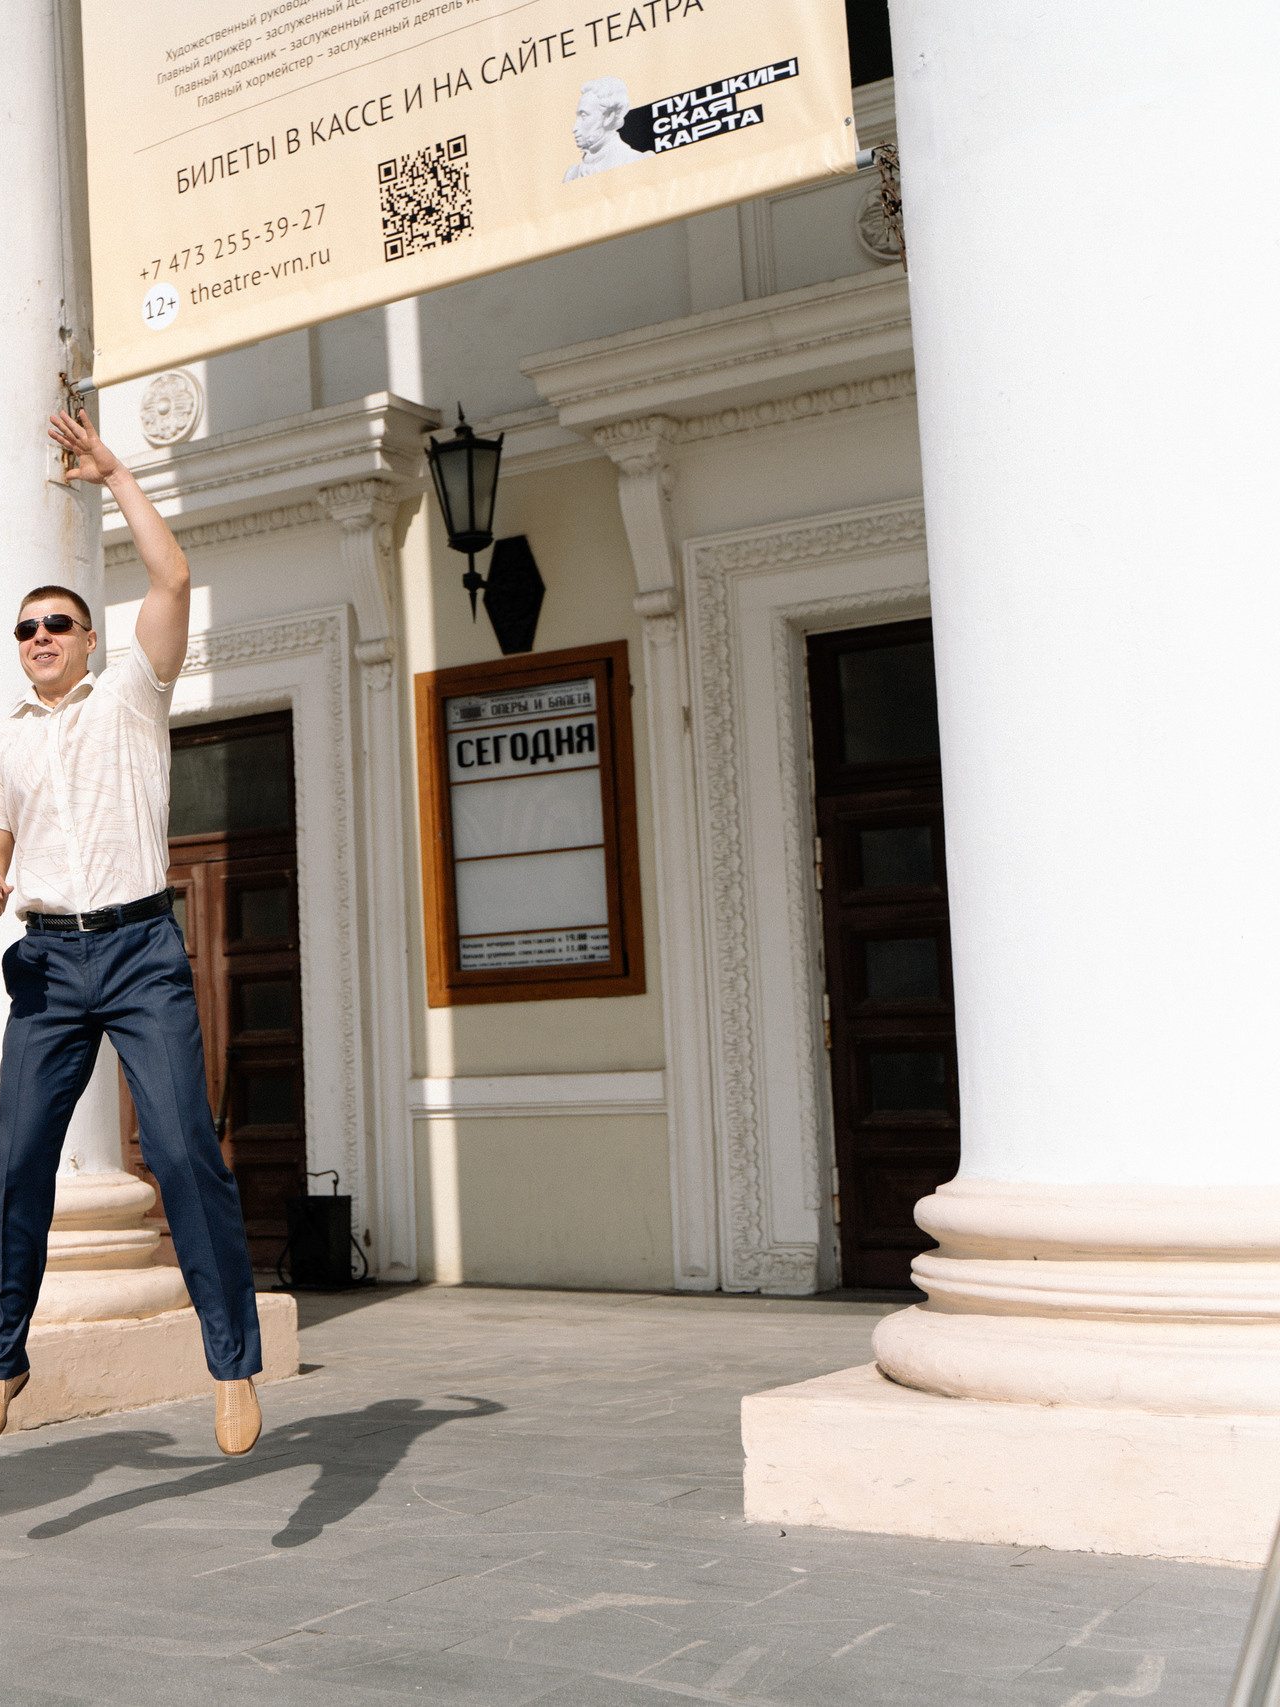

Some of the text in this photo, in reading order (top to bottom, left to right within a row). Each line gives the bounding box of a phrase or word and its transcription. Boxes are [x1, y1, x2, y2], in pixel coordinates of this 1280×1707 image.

[157, 59, 200, 85] Главный
[203, 38, 252, 67] дирижёр
[266, 2, 343, 41] заслуженный
[346, 0, 368, 9] де
[165, 0, 314, 62] Художественный руковод
[174, 70, 218, 97] Главный
[222, 49, 277, 79] художник
[290, 11, 370, 52] заслуженный
[197, 80, 242, 107] Главный
[246, 54, 313, 88] хормейстер
[327, 17, 409, 58] заслуженный
[414, 0, 463, 27] деятель
[177, 0, 704, 194] БИЛЕТЫ В КАССЕ И НА САЙТЕ ТЕАТРА
[651, 59, 797, 119] ПУШКИН
[652, 96, 734, 134] СКАЯ
[654, 106, 762, 153] КАРТА
[140, 203, 326, 280] +7 473 255-39-27
[189, 248, 331, 305] theatre-vrn.ru
[145, 296, 177, 320] 12+
[491, 700, 528, 716] ОПЕРЫ
[534, 697, 543, 711] И
[548, 692, 591, 709] БАЛЕТА
[456, 723, 596, 768] СЕГОДНЯ
